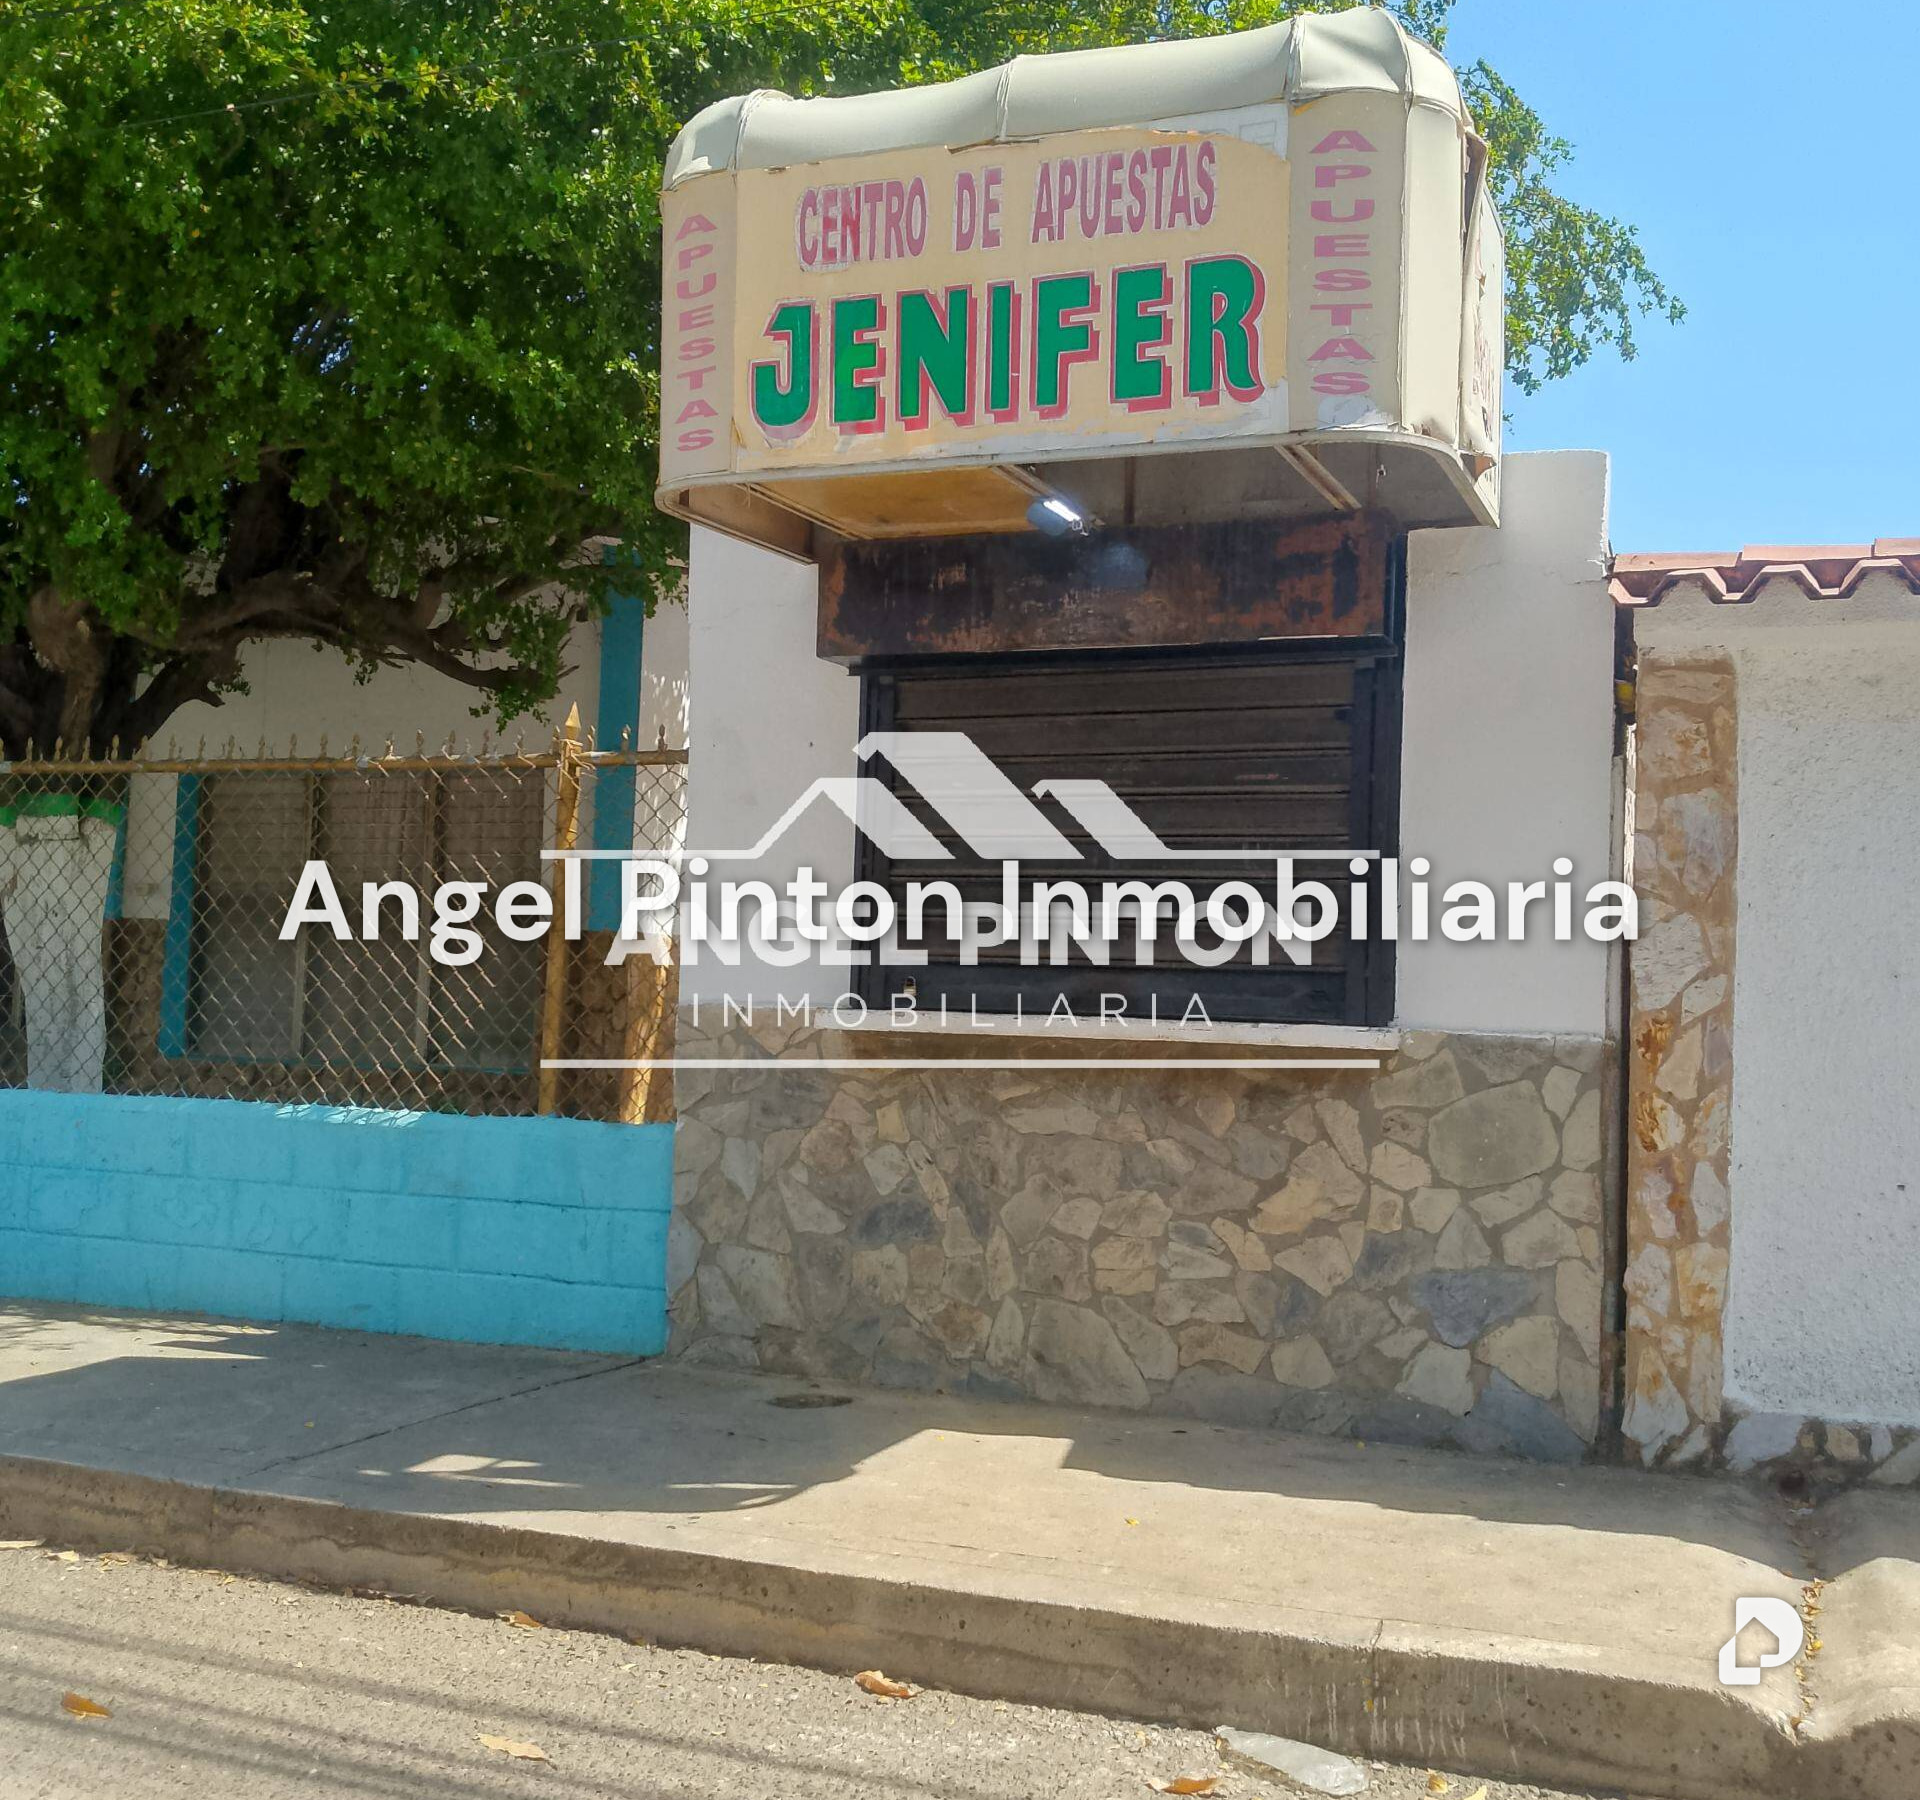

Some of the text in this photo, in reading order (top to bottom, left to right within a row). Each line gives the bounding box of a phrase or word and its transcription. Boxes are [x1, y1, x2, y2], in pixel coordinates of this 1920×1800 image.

[799, 141, 1217, 267] CENTRO DE APUESTAS
[1308, 130, 1378, 394] APUESTAS
[675, 214, 718, 451] APUESTAS
[749, 253, 1266, 440] JENIFER
